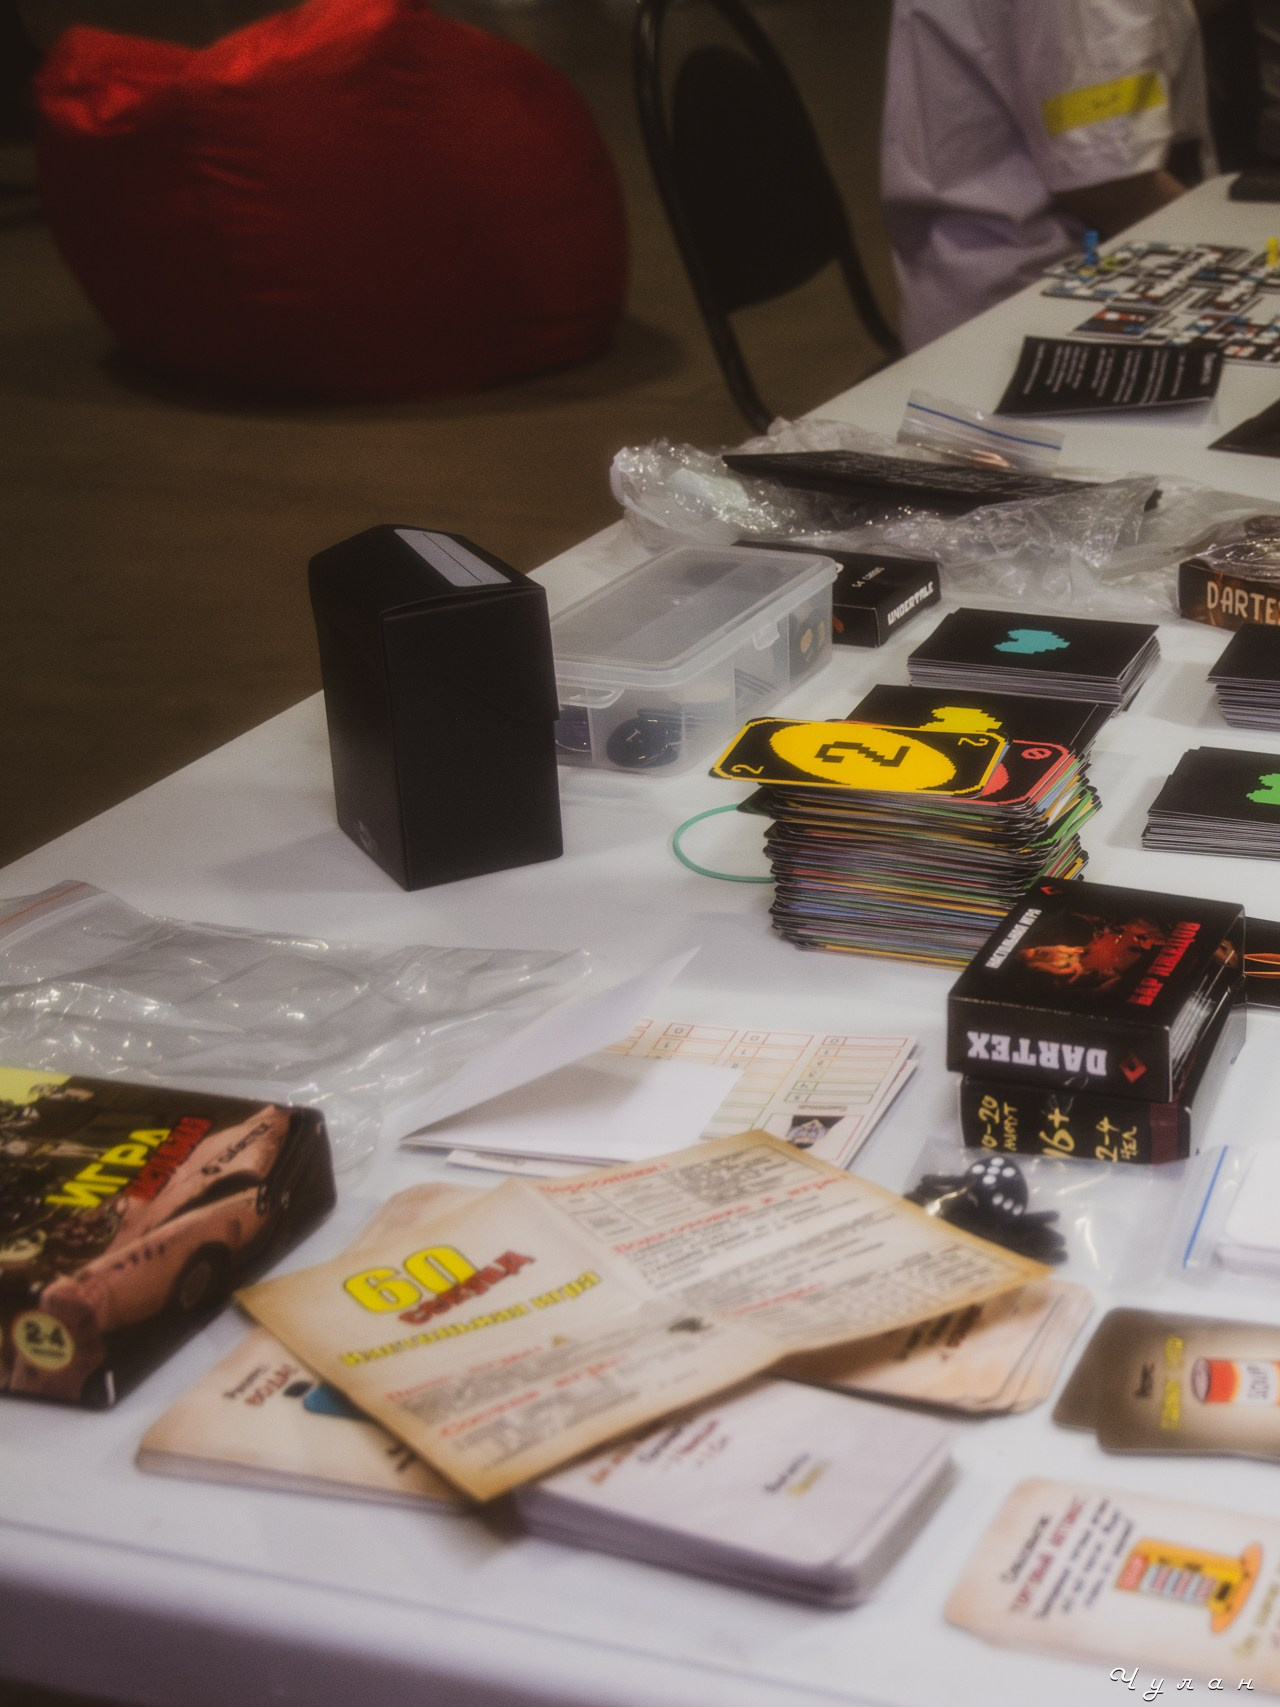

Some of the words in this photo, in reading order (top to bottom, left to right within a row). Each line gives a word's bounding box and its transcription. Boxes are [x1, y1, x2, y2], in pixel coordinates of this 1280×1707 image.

[887, 580, 934, 626] UNDERTALE
[731, 763, 765, 775] 2
[966, 1030, 1109, 1077] DARTEX
[44, 1127, 173, 1209] ИГРА
[342, 1244, 480, 1315] 60
[24, 1319, 67, 1347] 2-4
